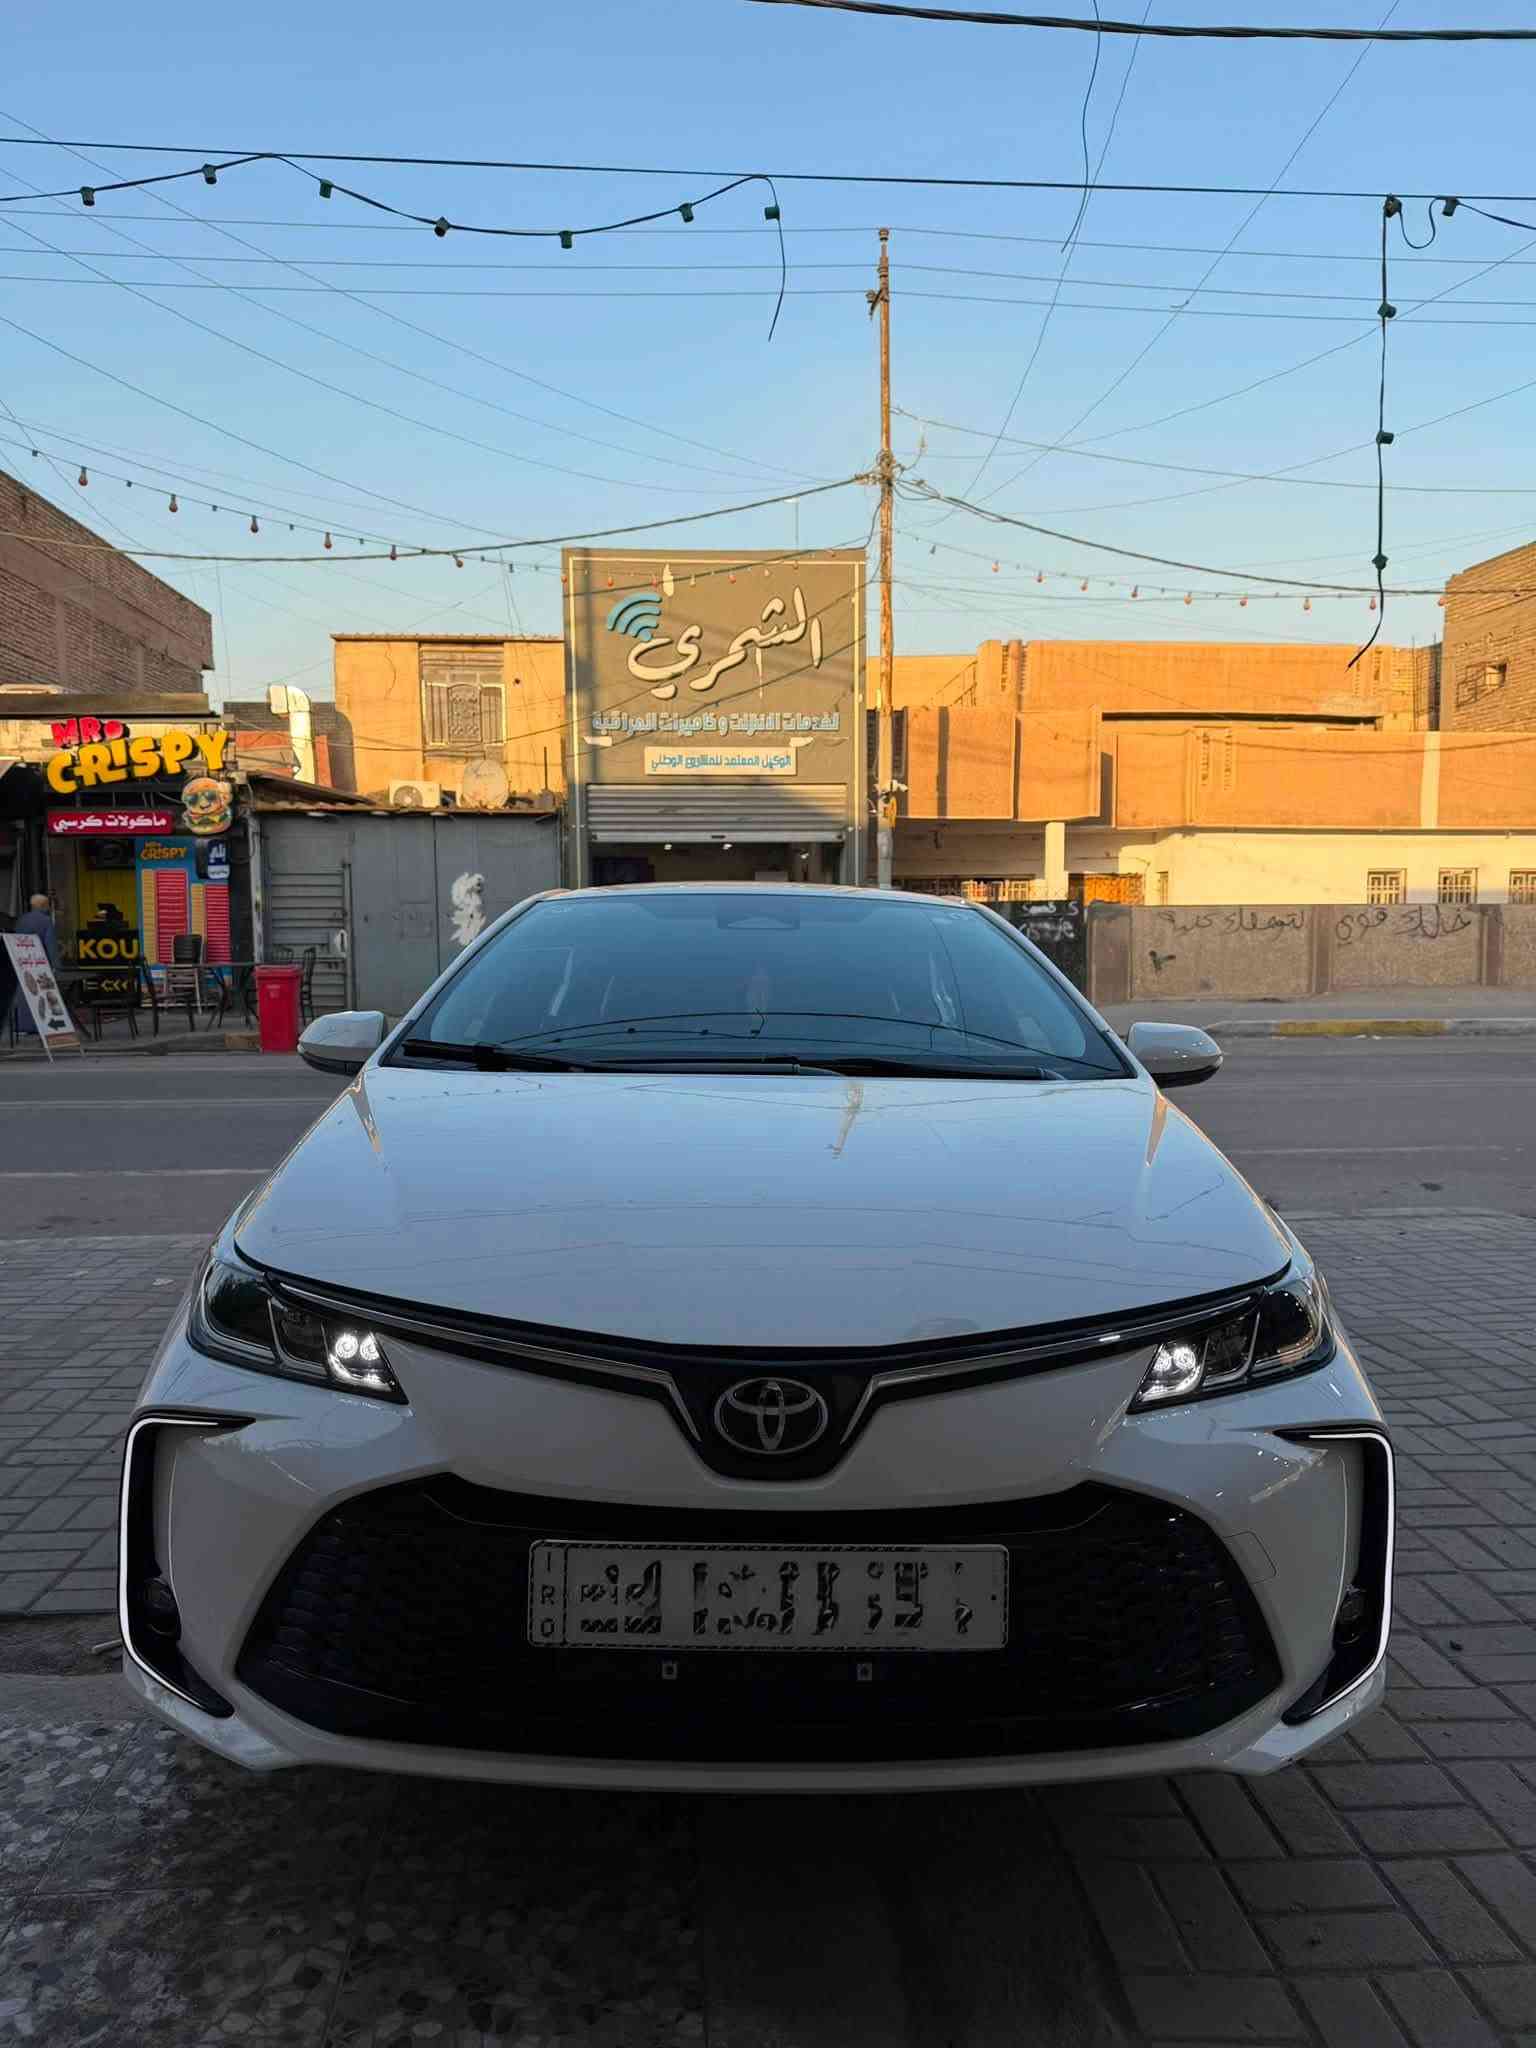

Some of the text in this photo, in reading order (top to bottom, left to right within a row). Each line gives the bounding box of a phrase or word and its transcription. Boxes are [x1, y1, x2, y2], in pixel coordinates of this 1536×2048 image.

[627, 585, 823, 700] الشمري
[592, 710, 658, 736] المراقبة
[783, 711, 840, 732] لخدمات
[46, 729, 230, 795] CRISPY
[651, 753, 792, 772] الوكيل المعتمد للمشروع الوطني
[140, 846, 188, 860] CRISPY
